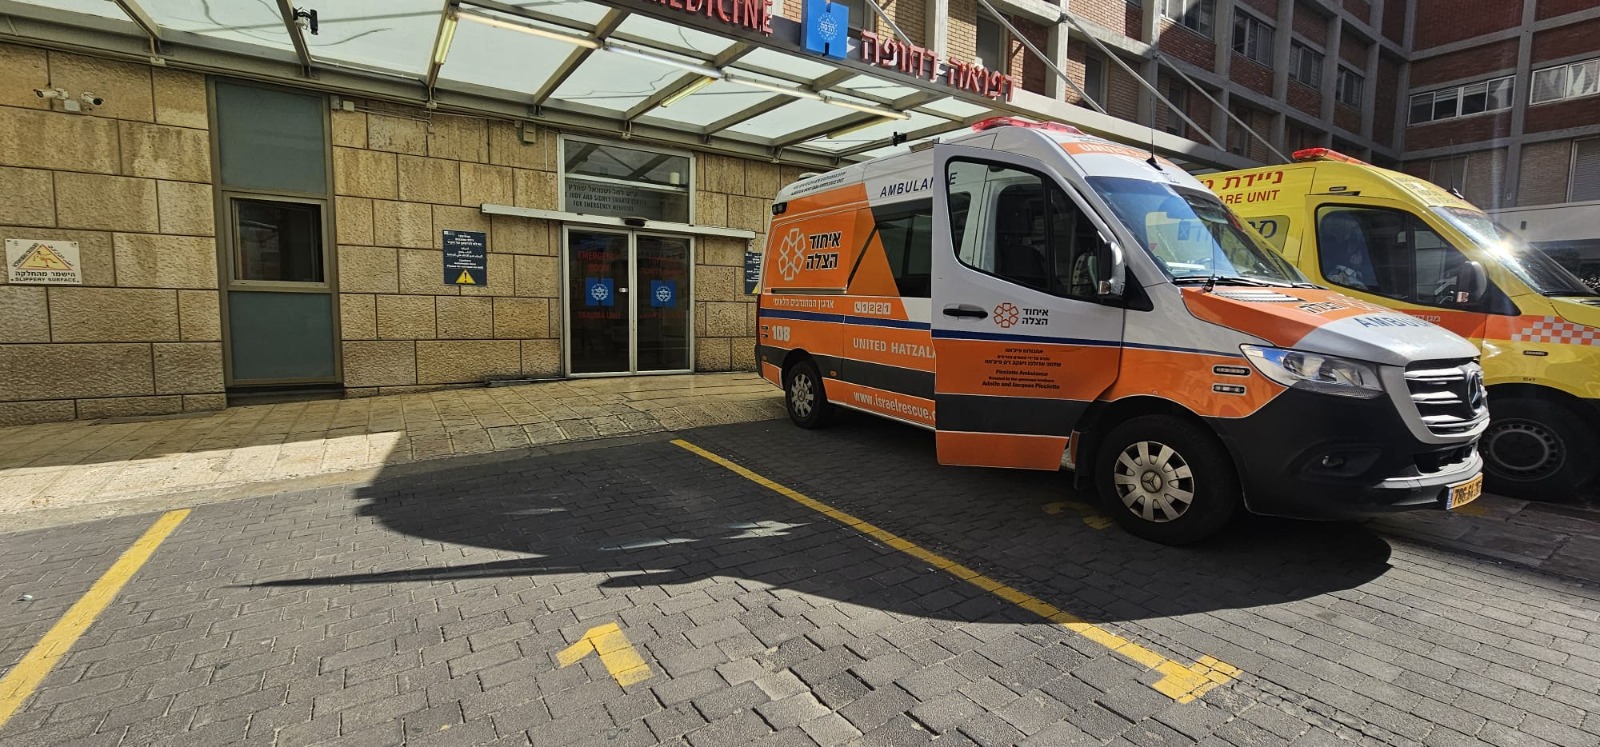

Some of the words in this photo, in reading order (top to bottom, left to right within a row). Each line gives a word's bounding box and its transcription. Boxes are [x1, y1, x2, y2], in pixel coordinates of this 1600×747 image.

[880, 172, 957, 198] AMBULAE
[1222, 170, 1284, 190] ניידת
[1247, 189, 1281, 203] UNIT
[809, 231, 842, 250] איחוד
[805, 252, 839, 270] הצלה
[862, 303, 890, 313] 1221
[1022, 308, 1049, 317] איחוד
[1021, 316, 1049, 326] הצלה
[771, 325, 791, 342] 108
[853, 337, 887, 352] UNITED
[555, 621, 653, 688] 1
